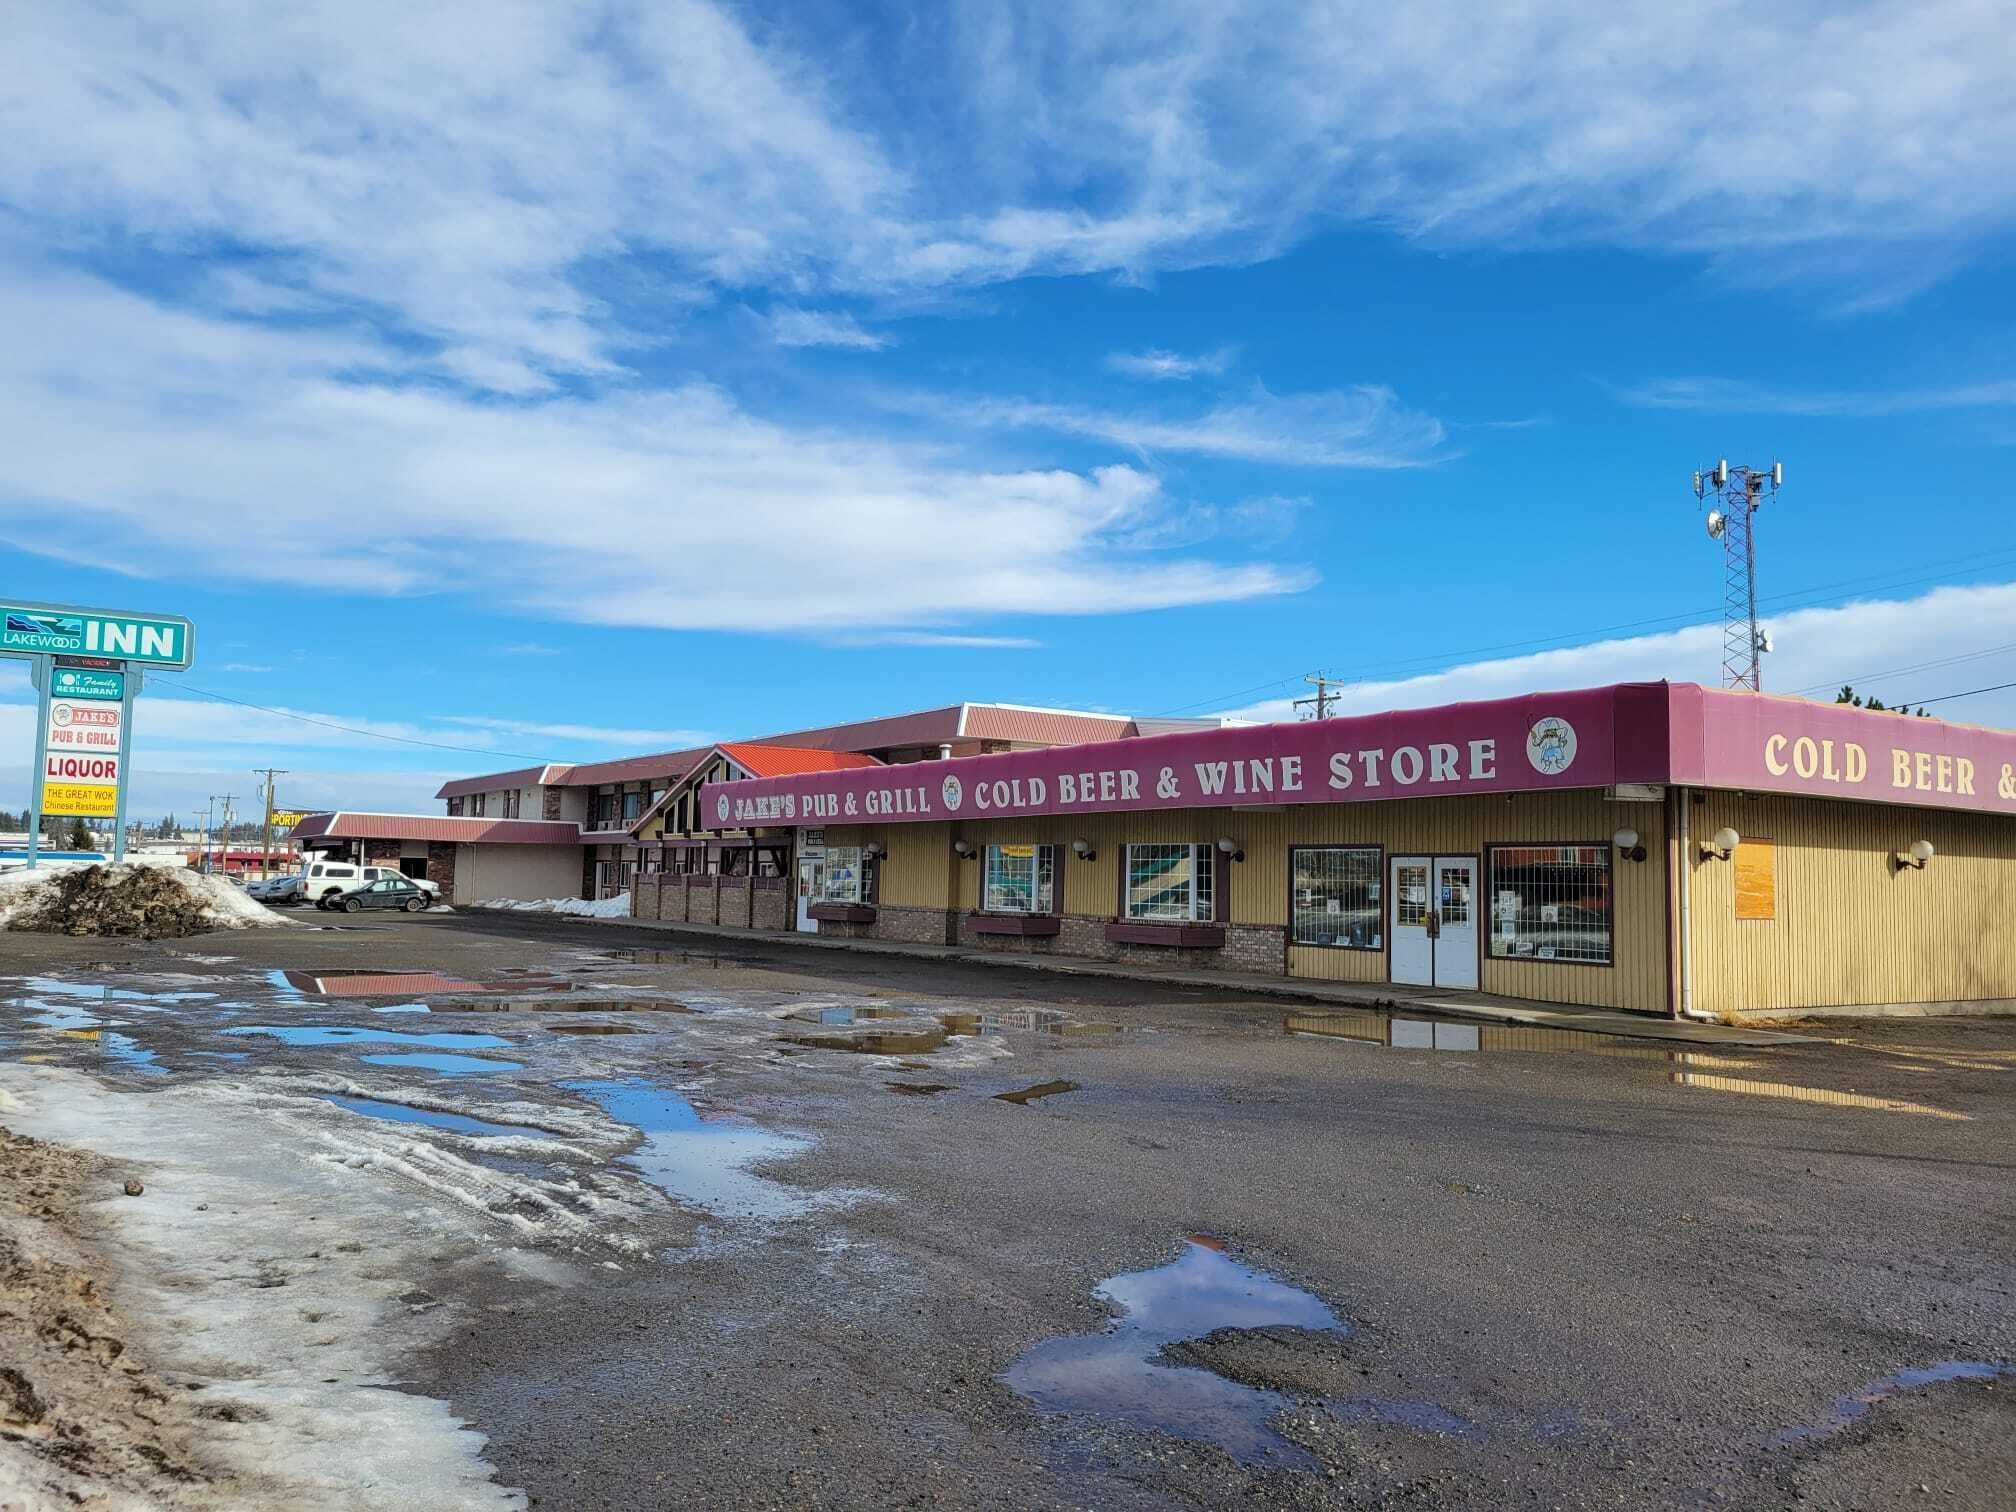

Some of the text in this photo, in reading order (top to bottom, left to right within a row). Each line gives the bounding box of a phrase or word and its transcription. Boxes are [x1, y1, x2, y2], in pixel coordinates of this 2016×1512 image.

[3, 620, 174, 657] LAKEWOOD INN
[83, 676, 117, 688] Family
[56, 685, 119, 696] RESTAURANT
[75, 711, 115, 723] JAKE'S
[52, 730, 117, 745] PUB & GRILL
[47, 758, 116, 778] LIQUOR
[1764, 734, 1867, 783] COLD
[1891, 748, 1976, 796] BEER
[975, 738, 1497, 810] COLD BEER & WINE STORE
[48, 788, 114, 800] THE GREAT WOK
[44, 801, 114, 812] Chinese Restaurant
[734, 786, 931, 821] JAKE'S PUB & GRILL
